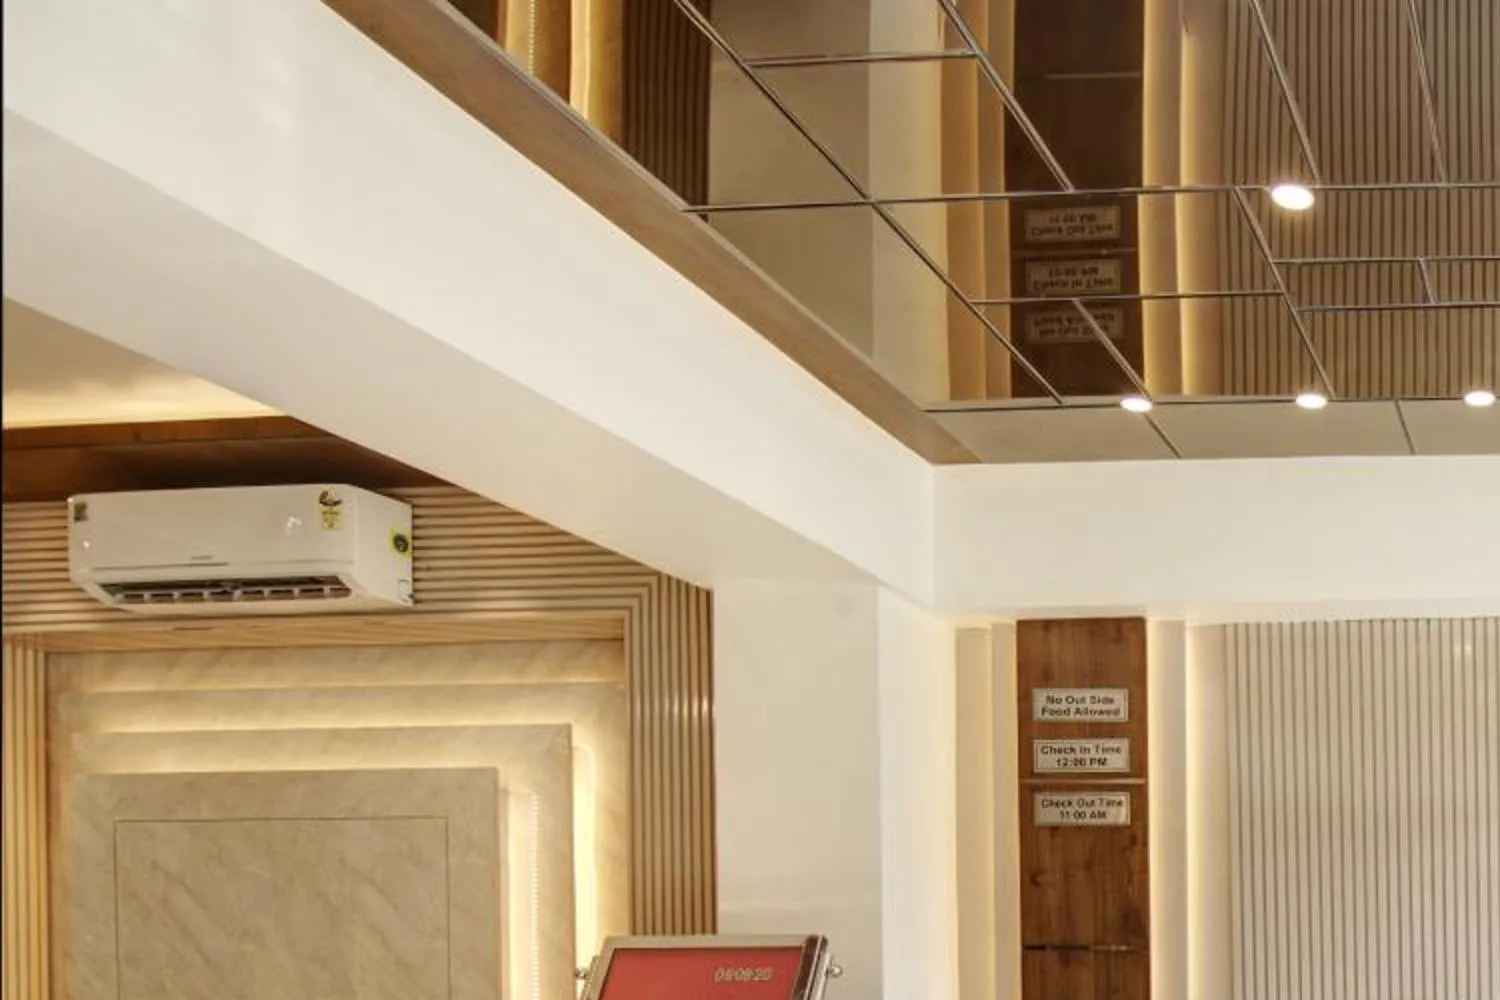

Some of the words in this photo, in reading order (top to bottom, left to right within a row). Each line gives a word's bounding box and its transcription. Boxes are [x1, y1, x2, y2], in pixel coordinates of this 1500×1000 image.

[1046, 695, 1062, 704] No
[1065, 695, 1086, 704] Out
[1041, 706, 1071, 717] Food
[1041, 745, 1076, 755] Check
[1094, 744, 1122, 754] Time
[1090, 757, 1108, 767] PM
[1041, 799, 1073, 809] Check
[1076, 798, 1095, 808] Out
[1098, 798, 1123, 808] Time
[1090, 810, 1107, 819] AM
